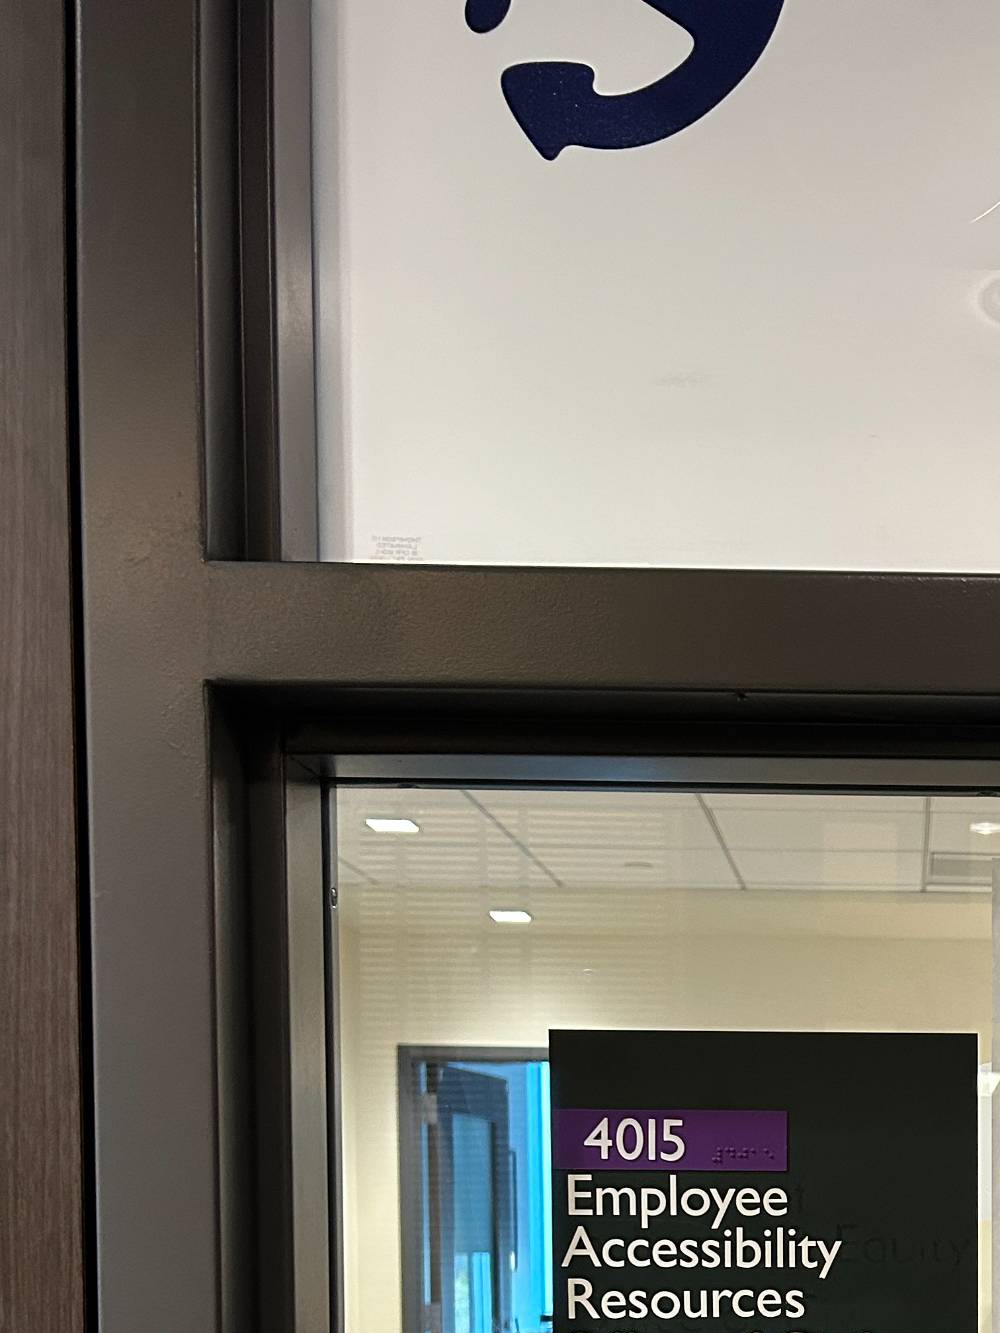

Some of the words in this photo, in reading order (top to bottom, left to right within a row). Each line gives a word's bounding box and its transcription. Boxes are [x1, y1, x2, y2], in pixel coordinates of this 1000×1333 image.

[583, 1117, 686, 1162] 4015
[567, 1173, 788, 1229] Employee
[561, 1225, 842, 1279] Accessibility
[567, 1278, 805, 1319] Resources
